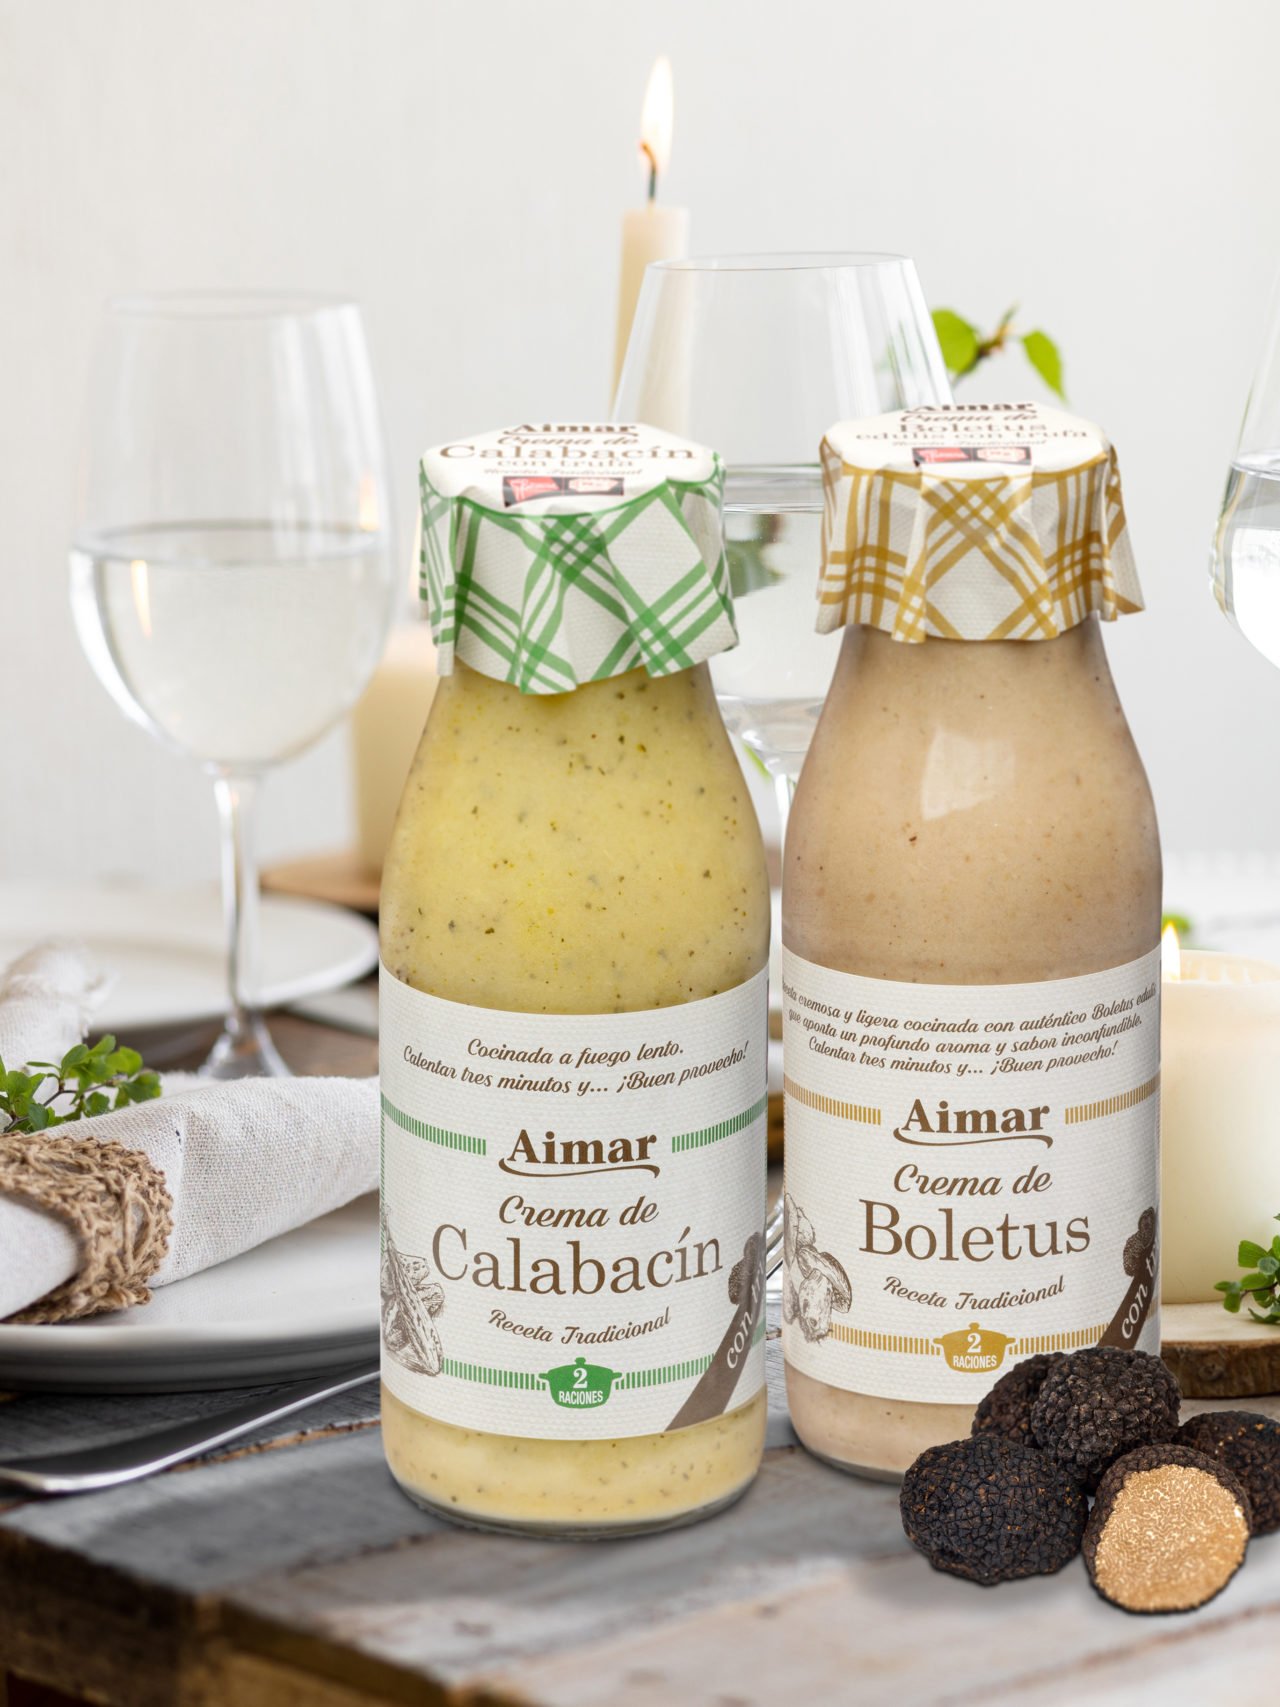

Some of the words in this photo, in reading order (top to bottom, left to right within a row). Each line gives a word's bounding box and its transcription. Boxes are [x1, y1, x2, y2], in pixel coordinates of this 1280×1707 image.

[497, 436, 593, 445] Crema
[602, 436, 639, 445] de
[511, 423, 636, 433] Aimar
[900, 423, 1047, 432] Boletus
[439, 445, 695, 459] Calabacín
[497, 459, 547, 467] con
[798, 995, 841, 1018] cremosa
[843, 1010, 853, 1024] y
[856, 1009, 898, 1028] ligera
[904, 1016, 979, 1033] cocinada
[984, 1019, 1014, 1033] con
[1019, 1011, 1087, 1032] auténtico
[1091, 998, 1134, 1020] Boletus
[788, 1009, 801, 1023] que
[803, 1017, 838, 1037] aporta
[840, 1030, 857, 1042] un
[859, 1033, 930, 1053] profundo
[935, 1039, 991, 1053] aroma
[995, 1042, 1007, 1056] y
[1011, 1033, 1056, 1052] sabor
[1060, 1013, 1142, 1049] inconfundible.
[403, 1045, 457, 1079] Calentar
[461, 1068, 493, 1087] tres
[497, 1074, 571, 1094] minutos
[576, 1080, 608, 1096] y...
[616, 1070, 675, 1094] ¡Buen
[678, 1040, 750, 1086] provecho!
[467, 1037, 553, 1065] Cocinada
[559, 1053, 573, 1065] a
[575, 1047, 631, 1068] fuego
[637, 1039, 684, 1060] lento.
[809, 1036, 856, 1062] Calentar
[859, 1050, 886, 1068] tres
[890, 1054, 952, 1074] minutos
[956, 1060, 983, 1076] y...
[990, 1053, 1043, 1075] ¡Buen
[1046, 1040, 1118, 1074] provecho!
[901, 1098, 1051, 1134] Aimar
[506, 1129, 657, 1165] Aimar
[893, 1163, 1004, 1196] Crema
[1012, 1164, 1054, 1194] de
[498, 1194, 610, 1228] Crema
[619, 1195, 660, 1226] de
[858, 1198, 1091, 1262] Boletus
[432, 1224, 723, 1296] Calabacín
[882, 1275, 948, 1308] Receta
[955, 1274, 1065, 1310] Tradicional
[488, 1308, 553, 1342] Receta
[560, 1306, 672, 1344] Tradicional
[1121, 1283, 1148, 1339] con
[727, 1311, 753, 1369] con
[966, 1332, 982, 1353] 2
[573, 1367, 588, 1389] 2
[952, 1353, 998, 1369] RACIONES
[558, 1390, 604, 1405] RACIONES
